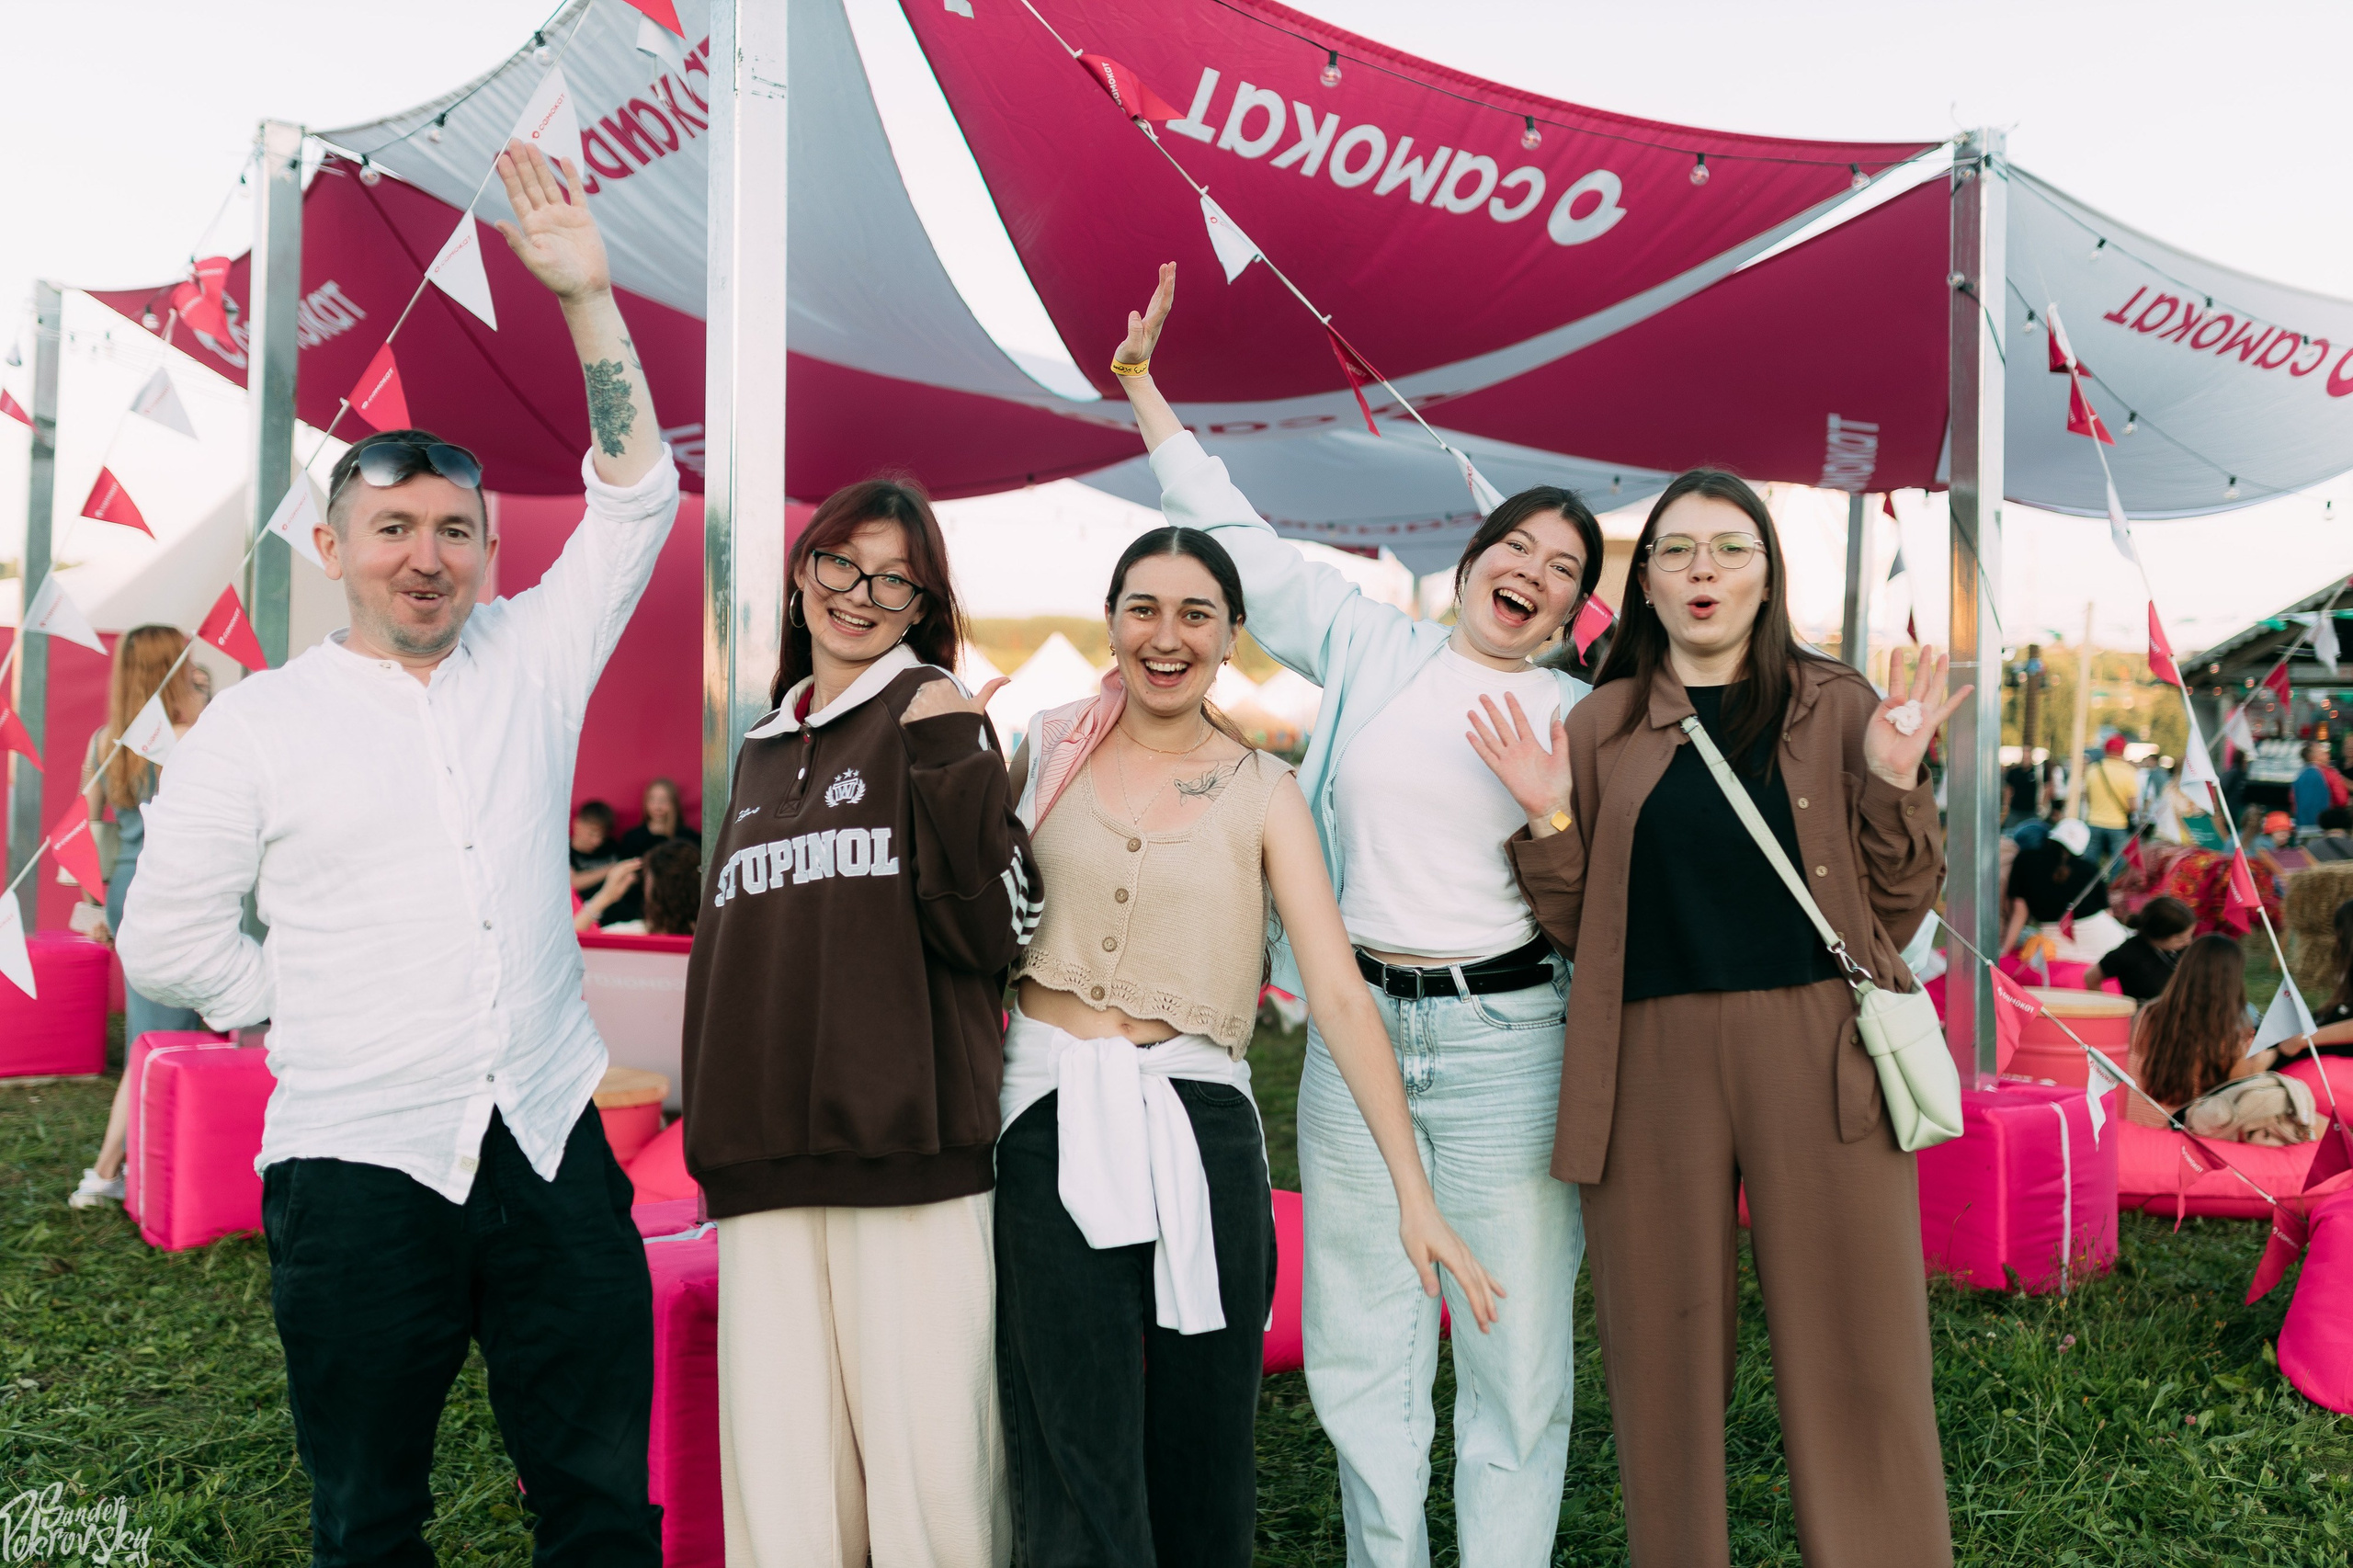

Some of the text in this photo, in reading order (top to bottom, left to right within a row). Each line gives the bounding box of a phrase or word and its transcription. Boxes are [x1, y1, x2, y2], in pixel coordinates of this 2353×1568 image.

[1165, 66, 1546, 223] самокат
[2103, 285, 2330, 377] самокат
[713, 827, 900, 908] STUPINOL
